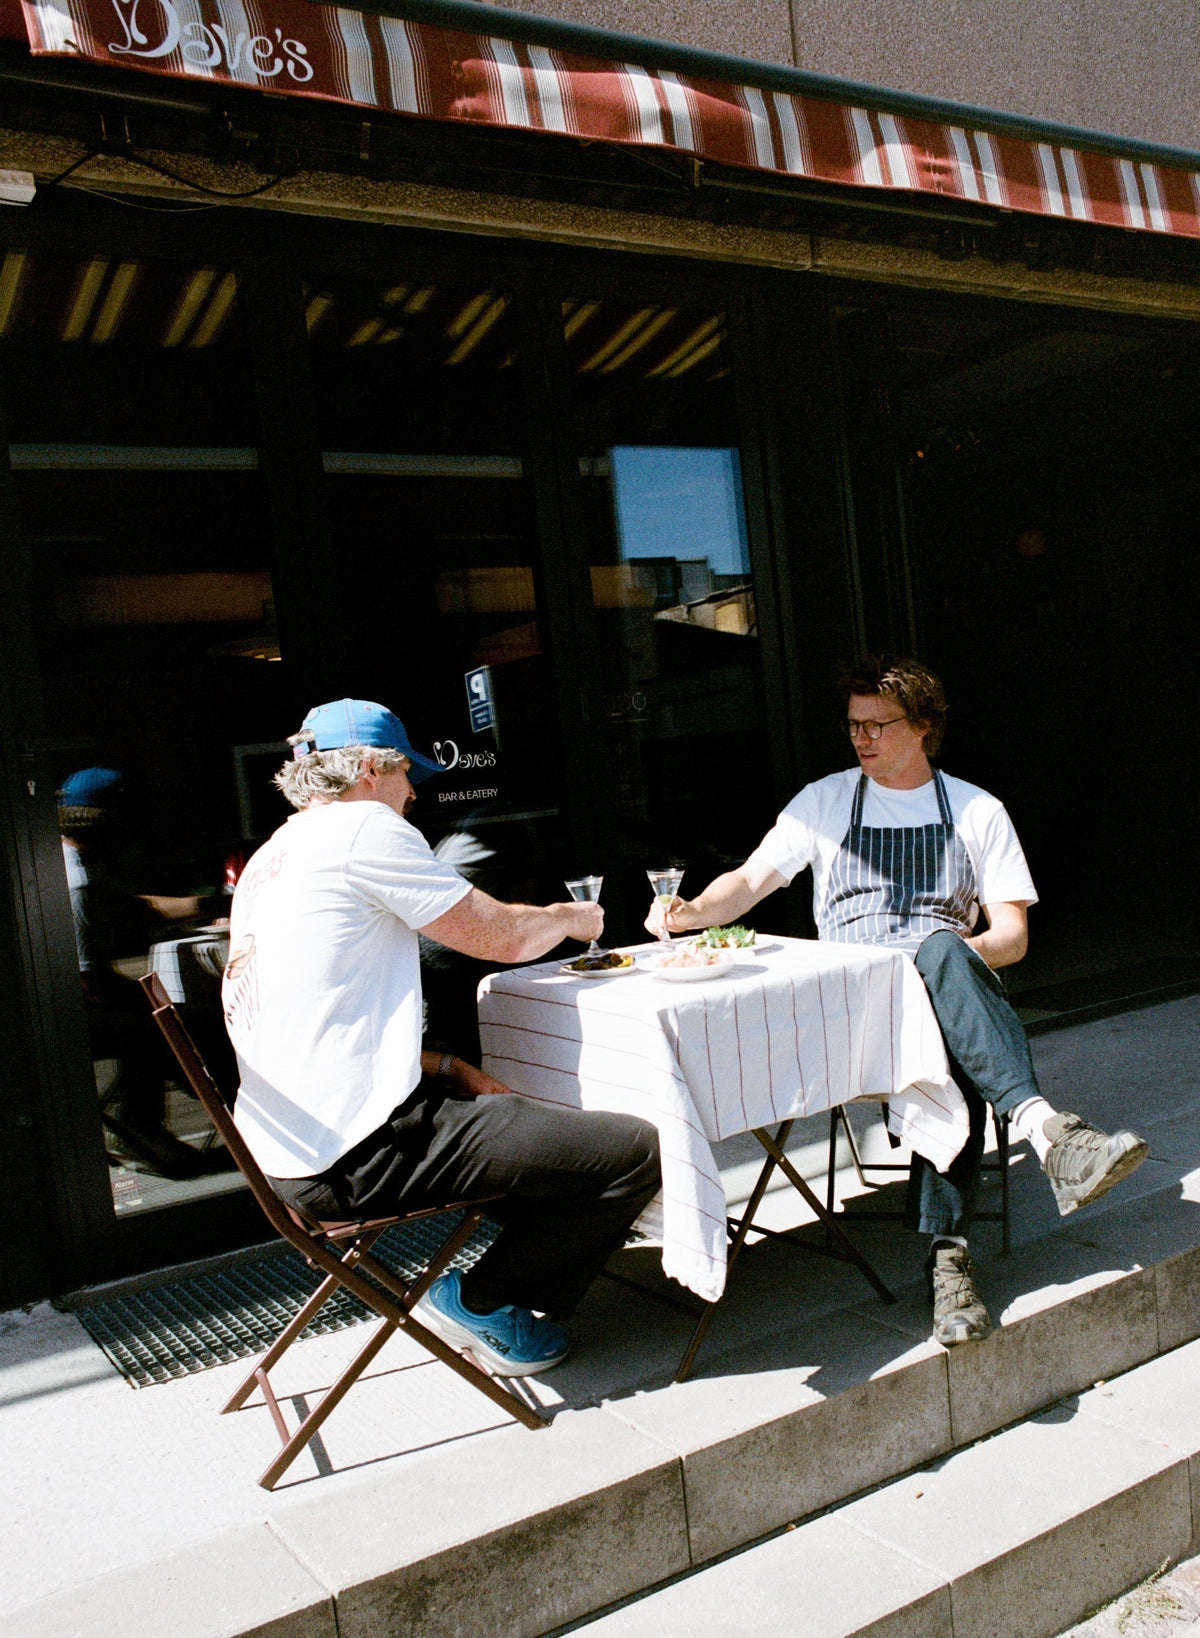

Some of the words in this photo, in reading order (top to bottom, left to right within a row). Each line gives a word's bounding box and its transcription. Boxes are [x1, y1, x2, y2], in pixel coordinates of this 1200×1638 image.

[108, 0, 314, 83] Dave's
[433, 740, 496, 770] Dave's
[438, 792, 457, 802] BAR
[458, 791, 465, 800] &
[467, 789, 498, 799] EATERY
[478, 1330, 511, 1355] HOKA
